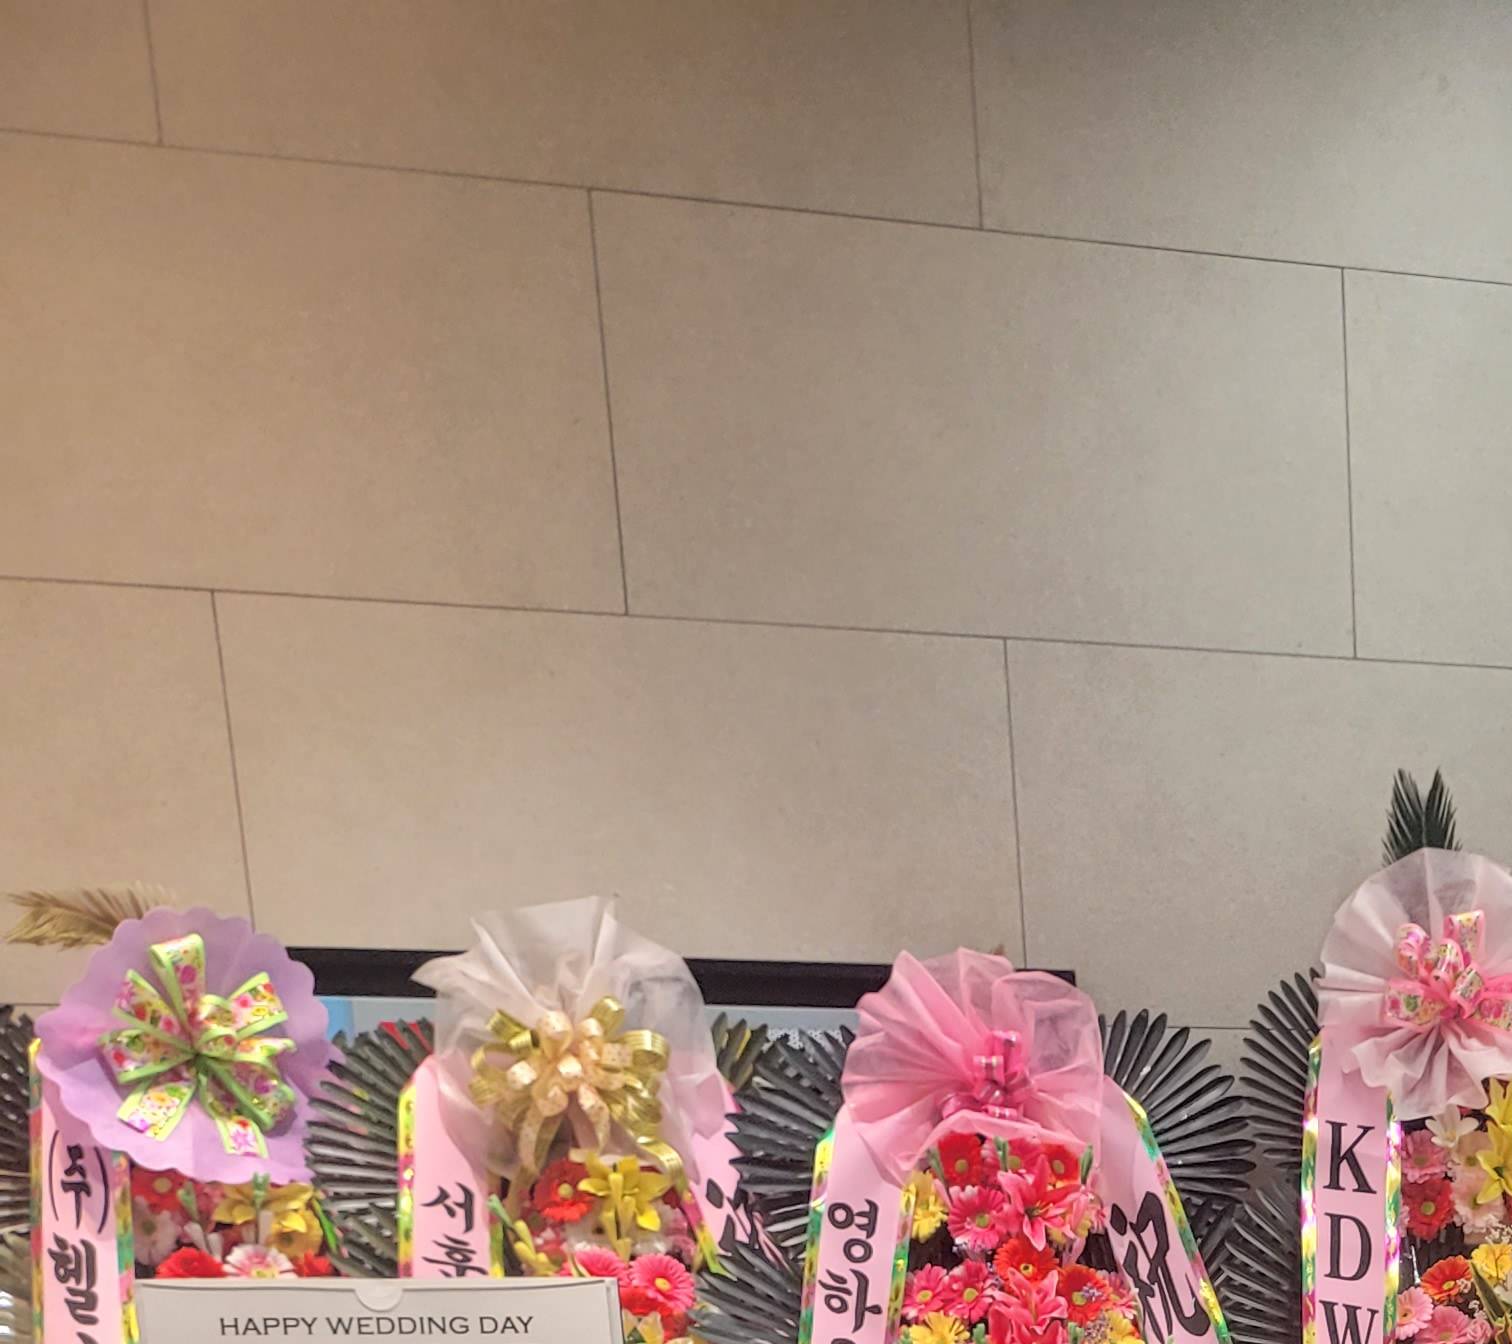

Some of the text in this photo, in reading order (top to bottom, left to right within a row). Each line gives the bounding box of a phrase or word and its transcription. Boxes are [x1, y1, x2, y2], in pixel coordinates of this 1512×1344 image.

[219, 1315, 534, 1336] HAPPY WEDDING DAY
